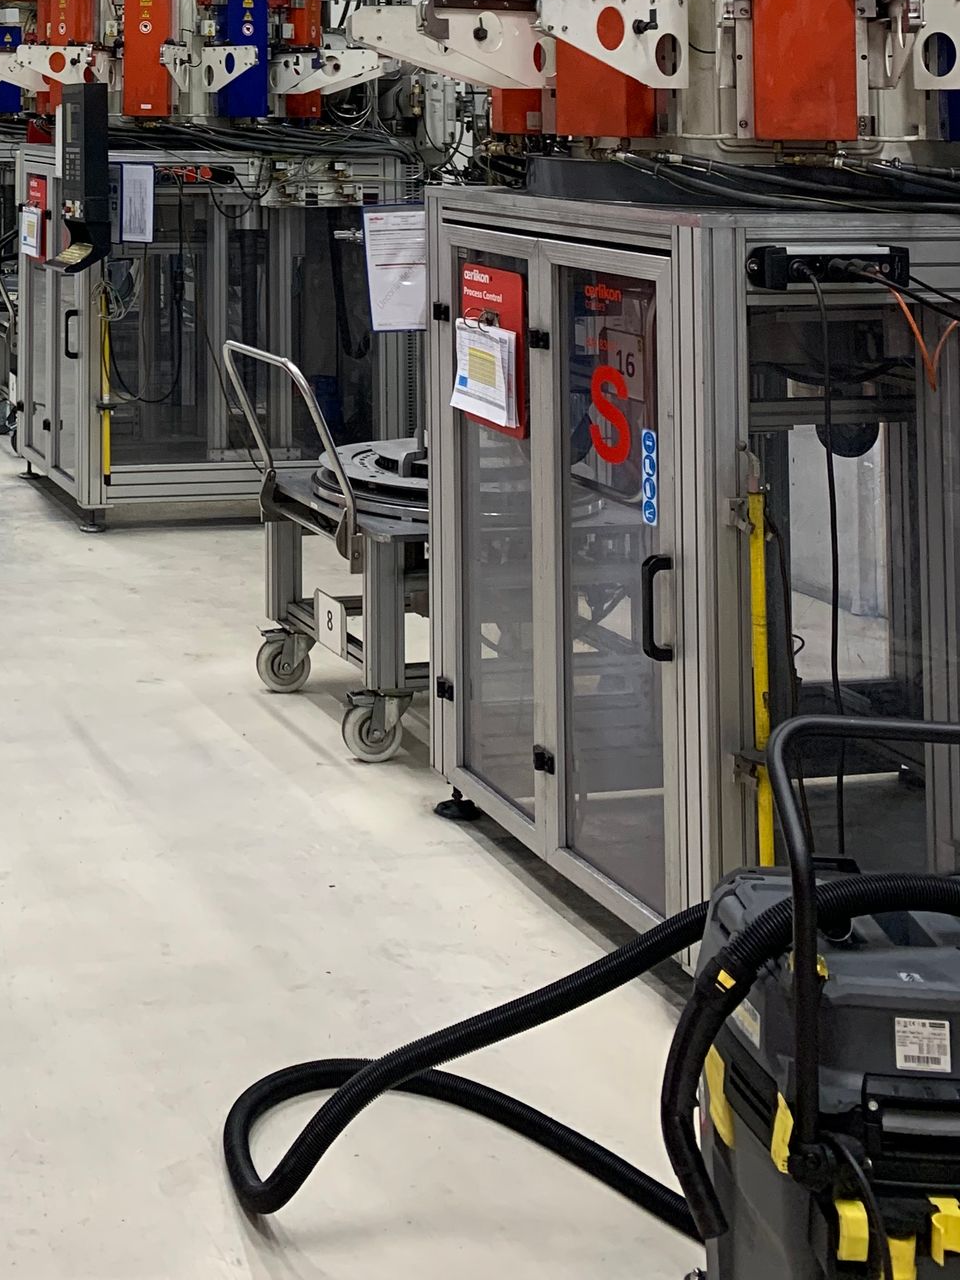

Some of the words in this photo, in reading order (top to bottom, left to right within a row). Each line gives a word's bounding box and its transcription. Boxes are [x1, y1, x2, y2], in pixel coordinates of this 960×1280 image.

[463, 286, 483, 299] Process
[482, 290, 503, 303] Control
[616, 349, 636, 378] 16
[589, 364, 631, 465] S
[326, 609, 333, 632] 8
